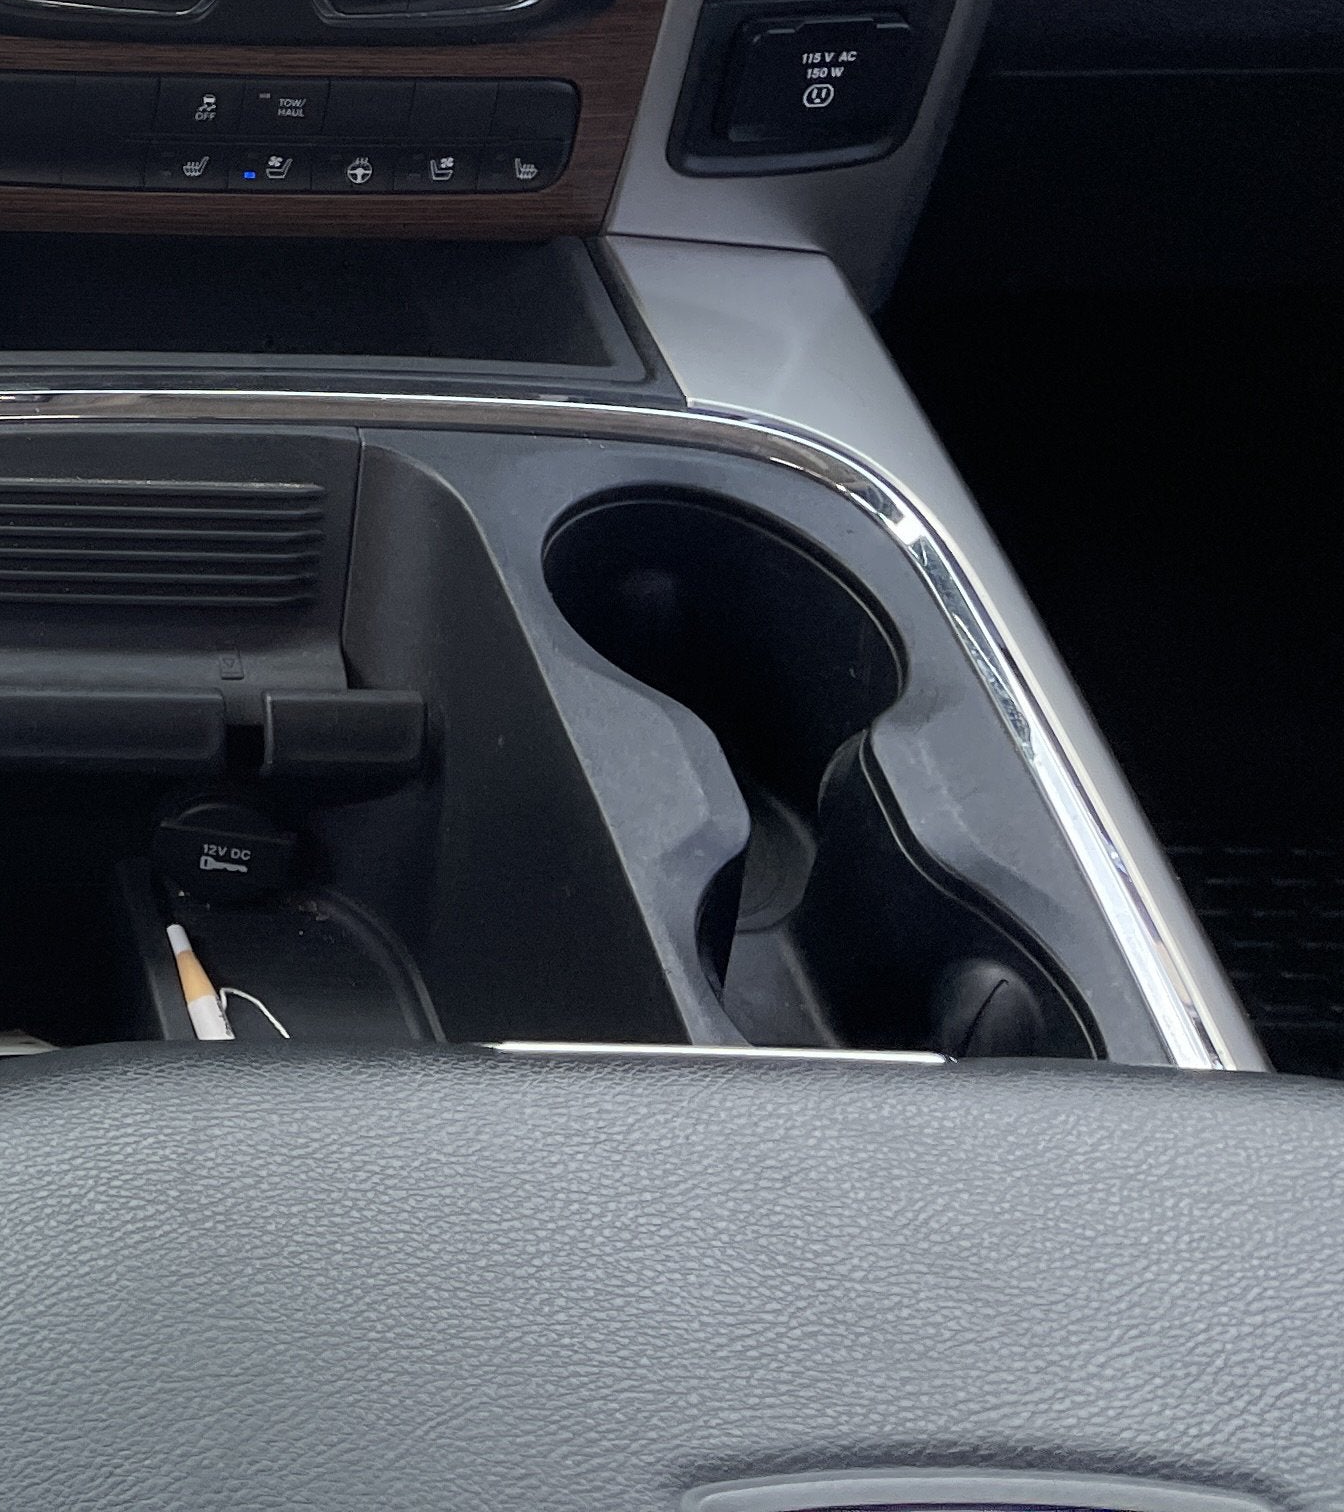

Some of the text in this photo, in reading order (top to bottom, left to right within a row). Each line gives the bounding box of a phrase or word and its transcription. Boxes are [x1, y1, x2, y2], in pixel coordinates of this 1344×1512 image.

[802, 51, 857, 64] 115 V AC
[807, 66, 845, 79] 150 W
[279, 98, 306, 107] TOW/
[195, 112, 216, 120] OFF
[277, 109, 304, 117] HAUL
[203, 844, 251, 860] 12V DC
